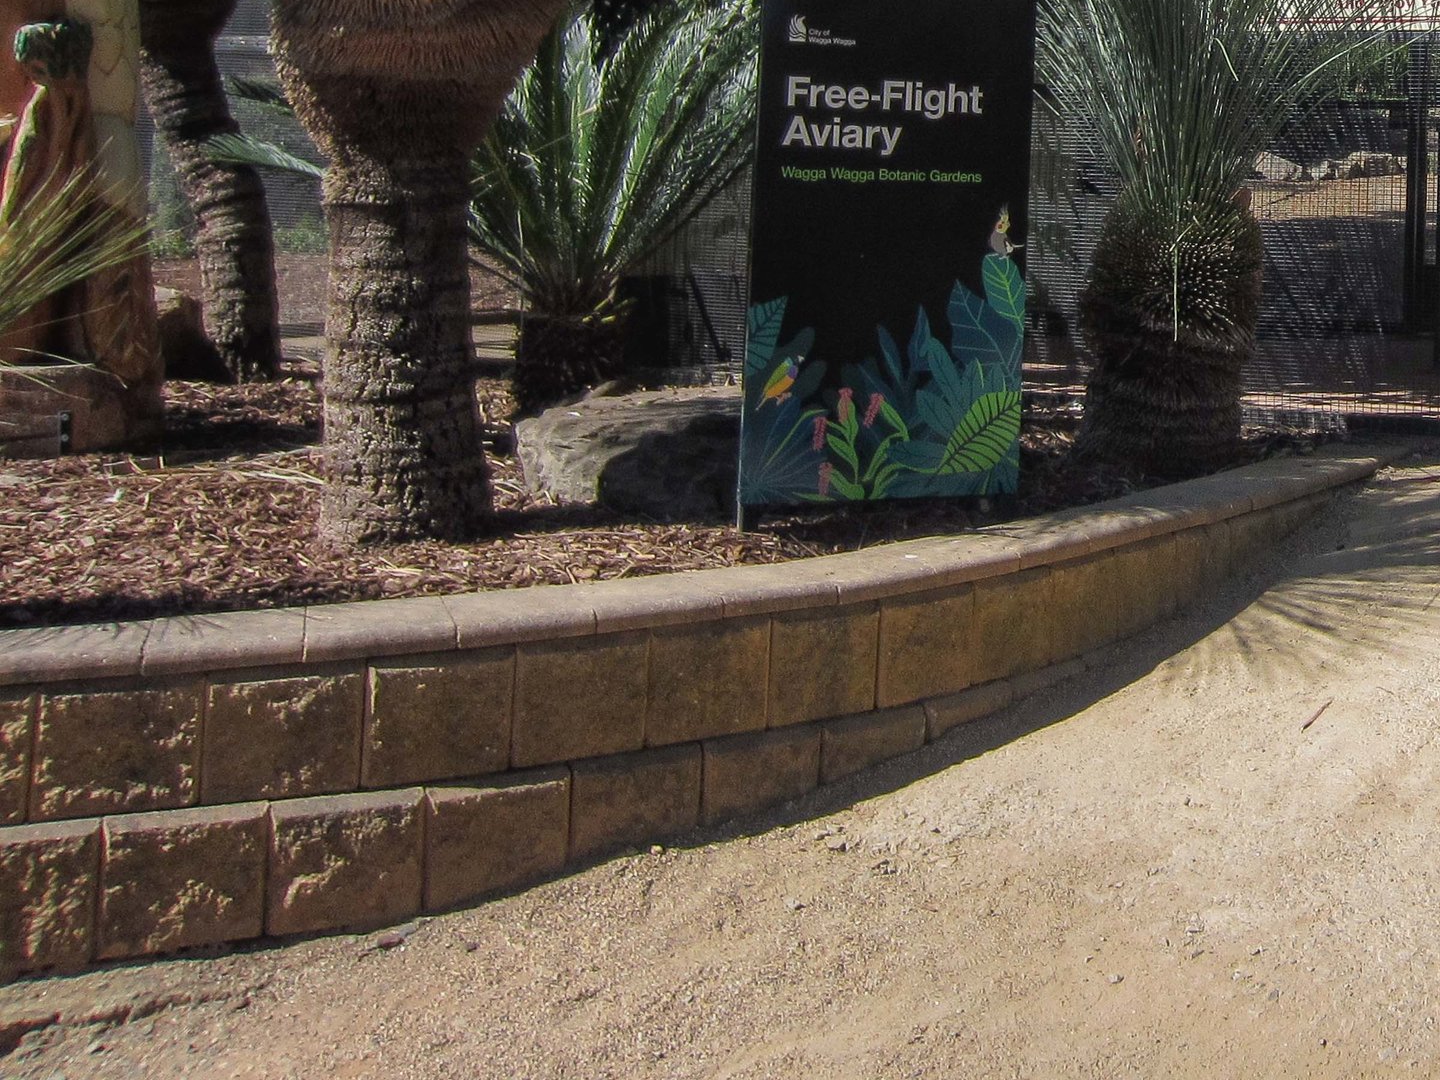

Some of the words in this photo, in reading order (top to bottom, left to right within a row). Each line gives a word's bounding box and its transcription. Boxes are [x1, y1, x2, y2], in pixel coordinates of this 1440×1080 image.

[808, 36, 832, 45] Wagga
[832, 37, 857, 46] Wagga
[786, 74, 984, 120] Free-Flight
[781, 115, 903, 157] Aviary
[781, 165, 827, 182] Wagga
[830, 166, 876, 183] Wagga
[878, 168, 926, 182] Botanic
[929, 169, 983, 184] Gardens
